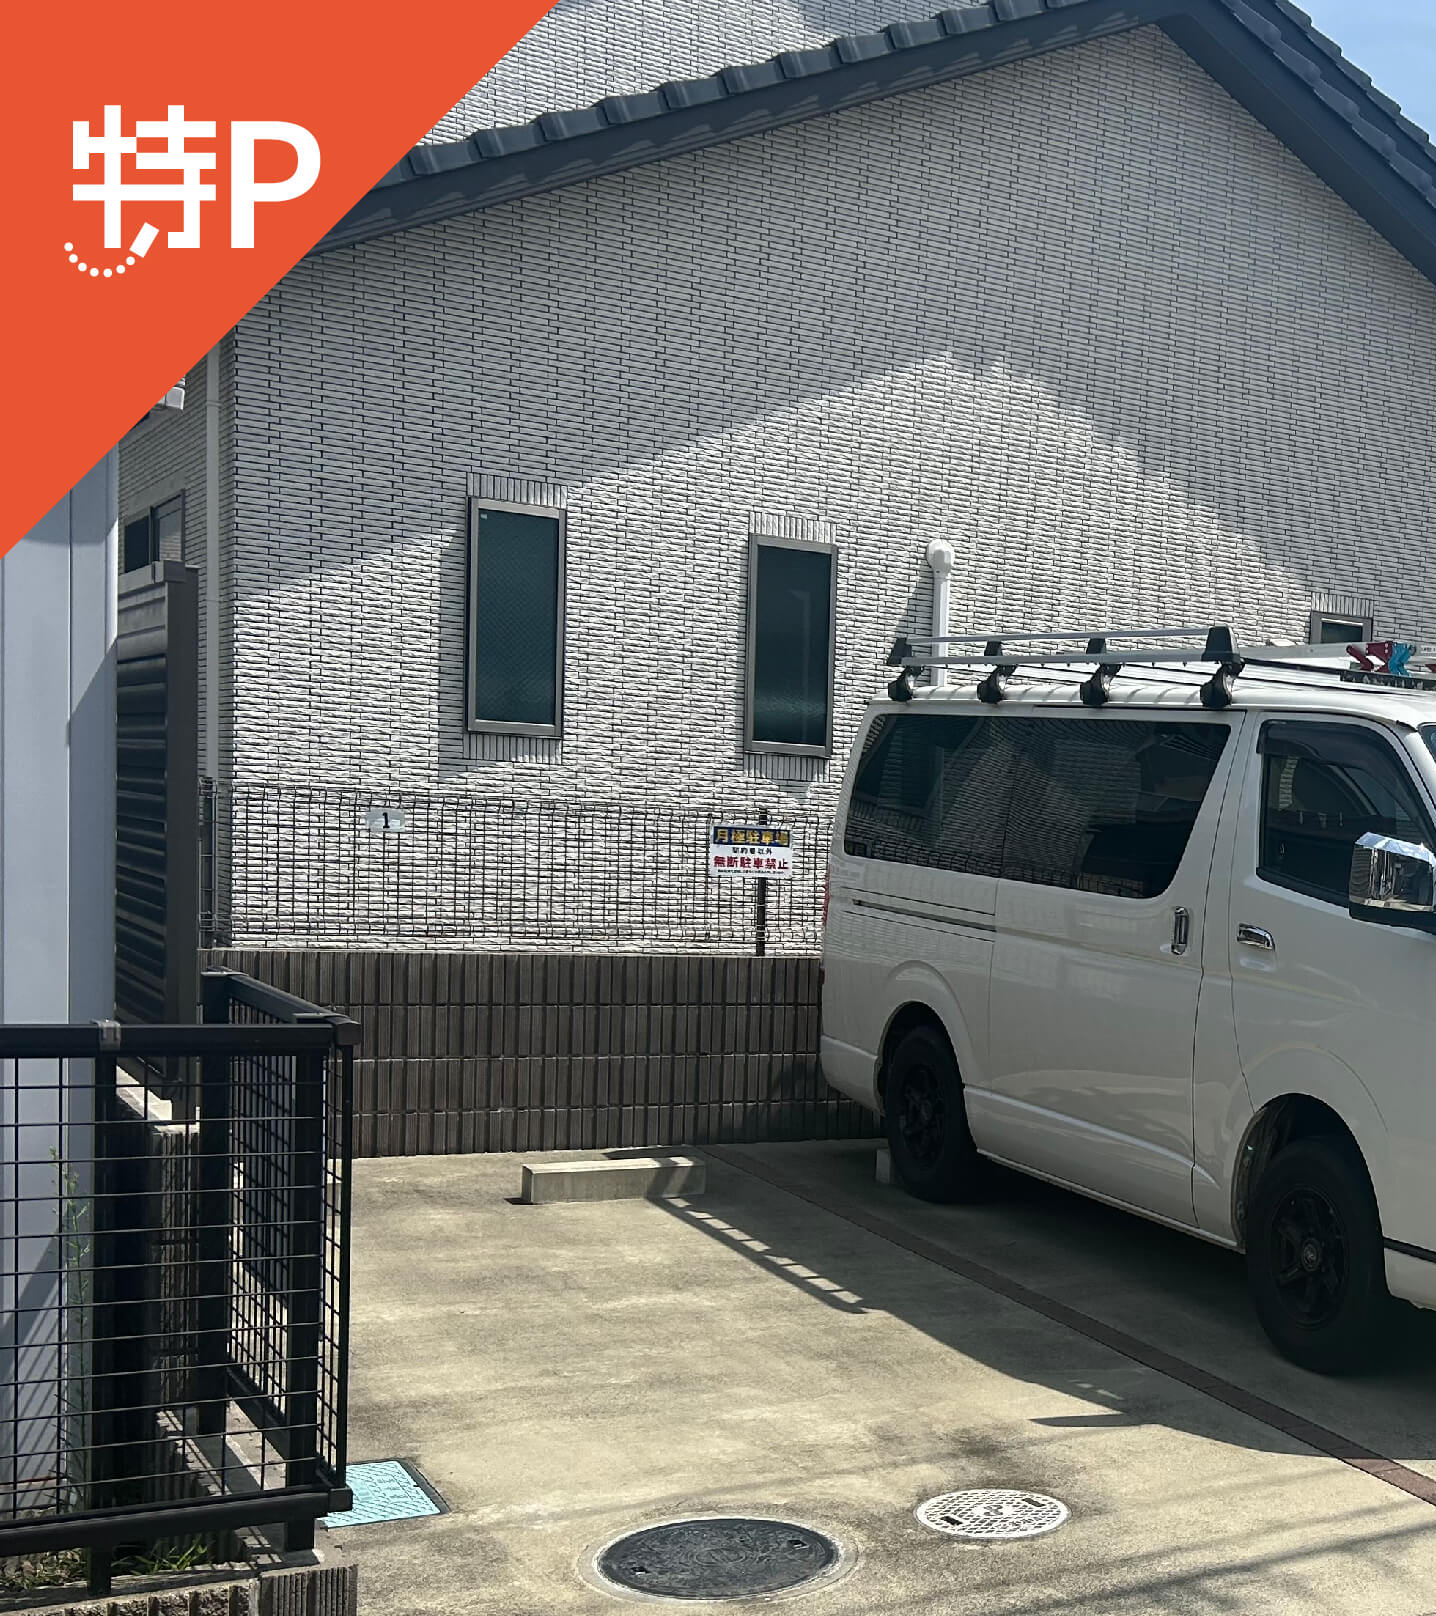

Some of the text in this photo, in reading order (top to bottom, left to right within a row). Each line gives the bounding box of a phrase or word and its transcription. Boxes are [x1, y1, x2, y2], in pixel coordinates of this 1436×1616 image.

[382, 812, 390, 828] 1
[716, 828, 788, 846] 月極駐車場
[714, 855, 789, 870] 無断駐車禁止
